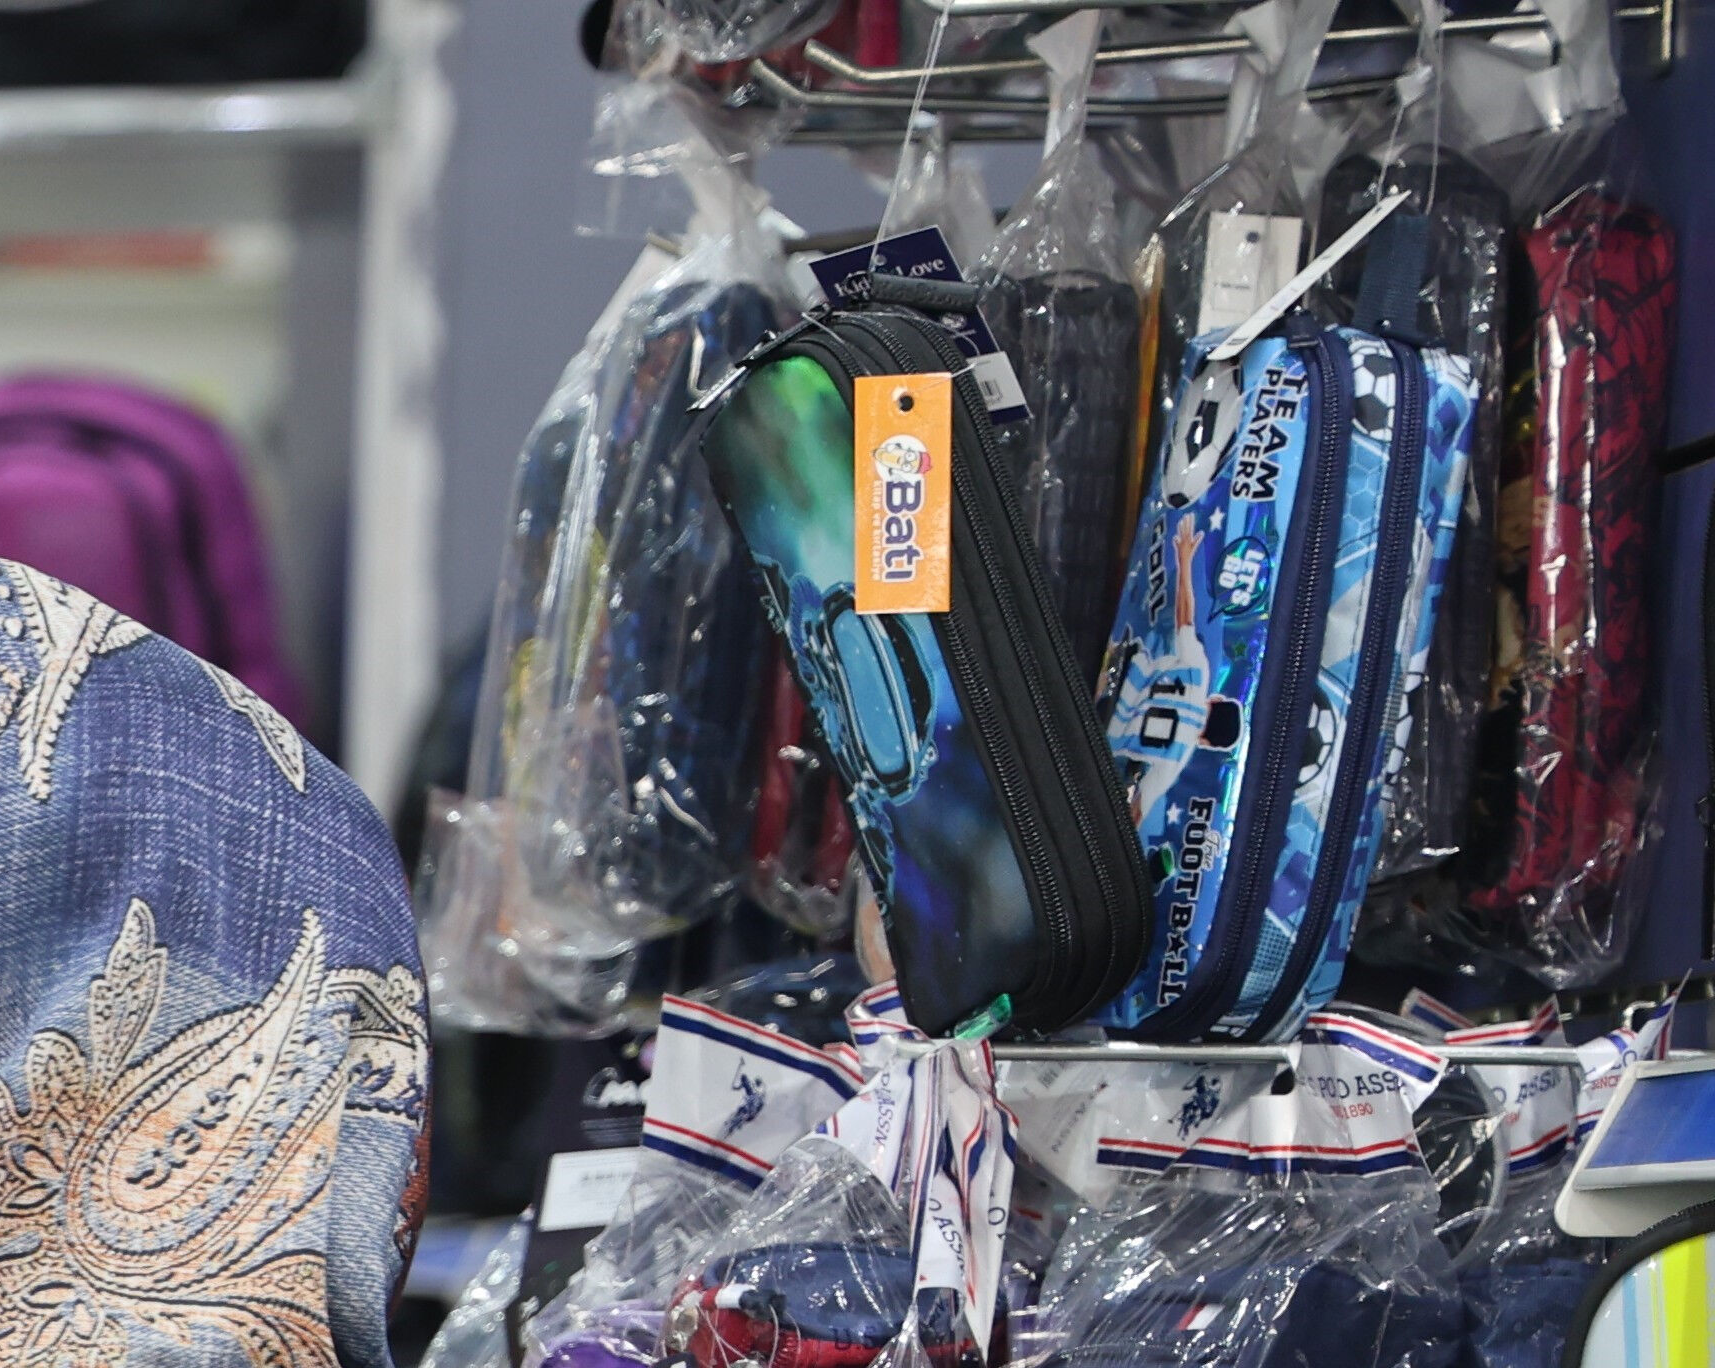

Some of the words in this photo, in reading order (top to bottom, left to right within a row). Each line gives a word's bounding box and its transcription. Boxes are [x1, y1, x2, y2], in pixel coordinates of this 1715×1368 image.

[1231, 368, 1284, 499] PLAYERS
[1251, 371, 1308, 500] TEAM
[883, 479, 925, 582] Batı
